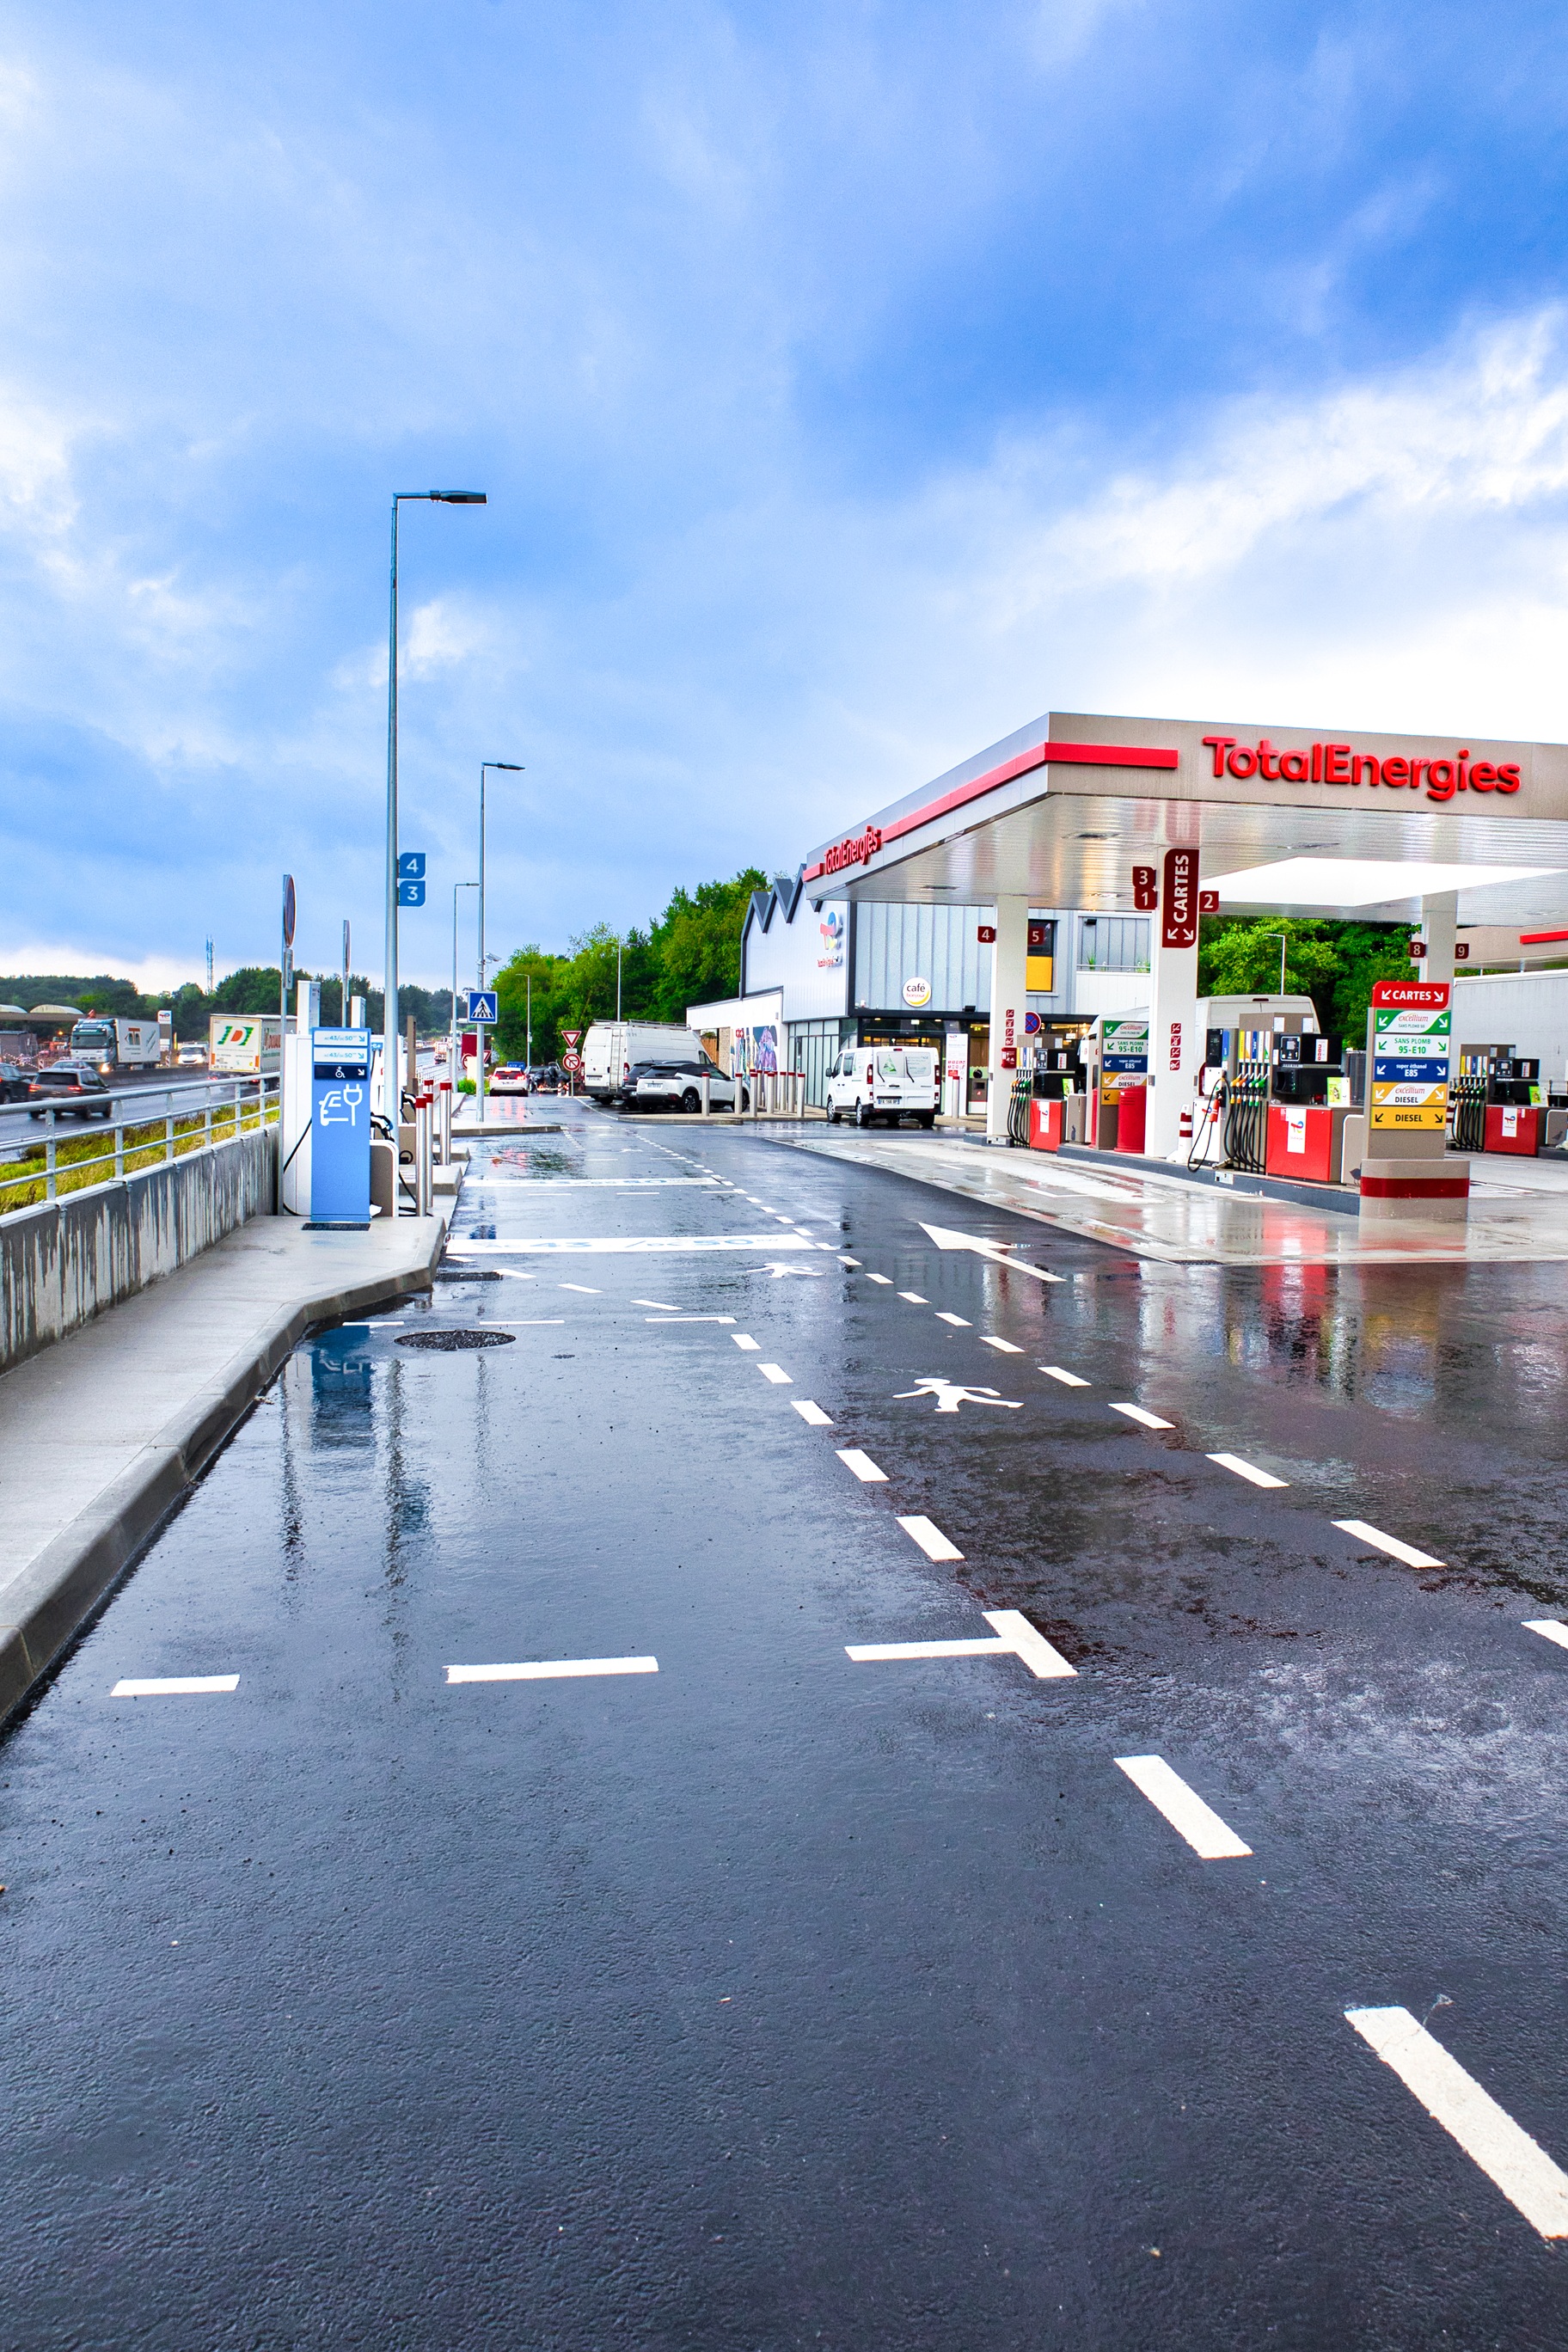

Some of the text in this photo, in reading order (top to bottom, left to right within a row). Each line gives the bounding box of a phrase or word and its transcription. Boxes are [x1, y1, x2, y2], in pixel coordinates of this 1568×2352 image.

[1203, 736, 1522, 801] TotalEnergies
[824, 825, 882, 875] TotalEnergies
[406, 858, 420, 873] 4
[1138, 870, 1148, 885] 3
[407, 885, 419, 901] 3
[1173, 854, 1190, 923] CARTES
[1141, 892, 1148, 906] 1
[1204, 894, 1213, 909] 2
[981, 929, 990, 940] 4
[1032, 931, 1039, 942] 5
[1413, 944, 1421, 955] 8
[1457, 946, 1465, 957] 9
[906, 983, 926, 993] café
[1393, 990, 1431, 1001] CARTES
[1398, 1013, 1429, 1022] excellium
[1395, 1086, 1425, 1094] excellium
